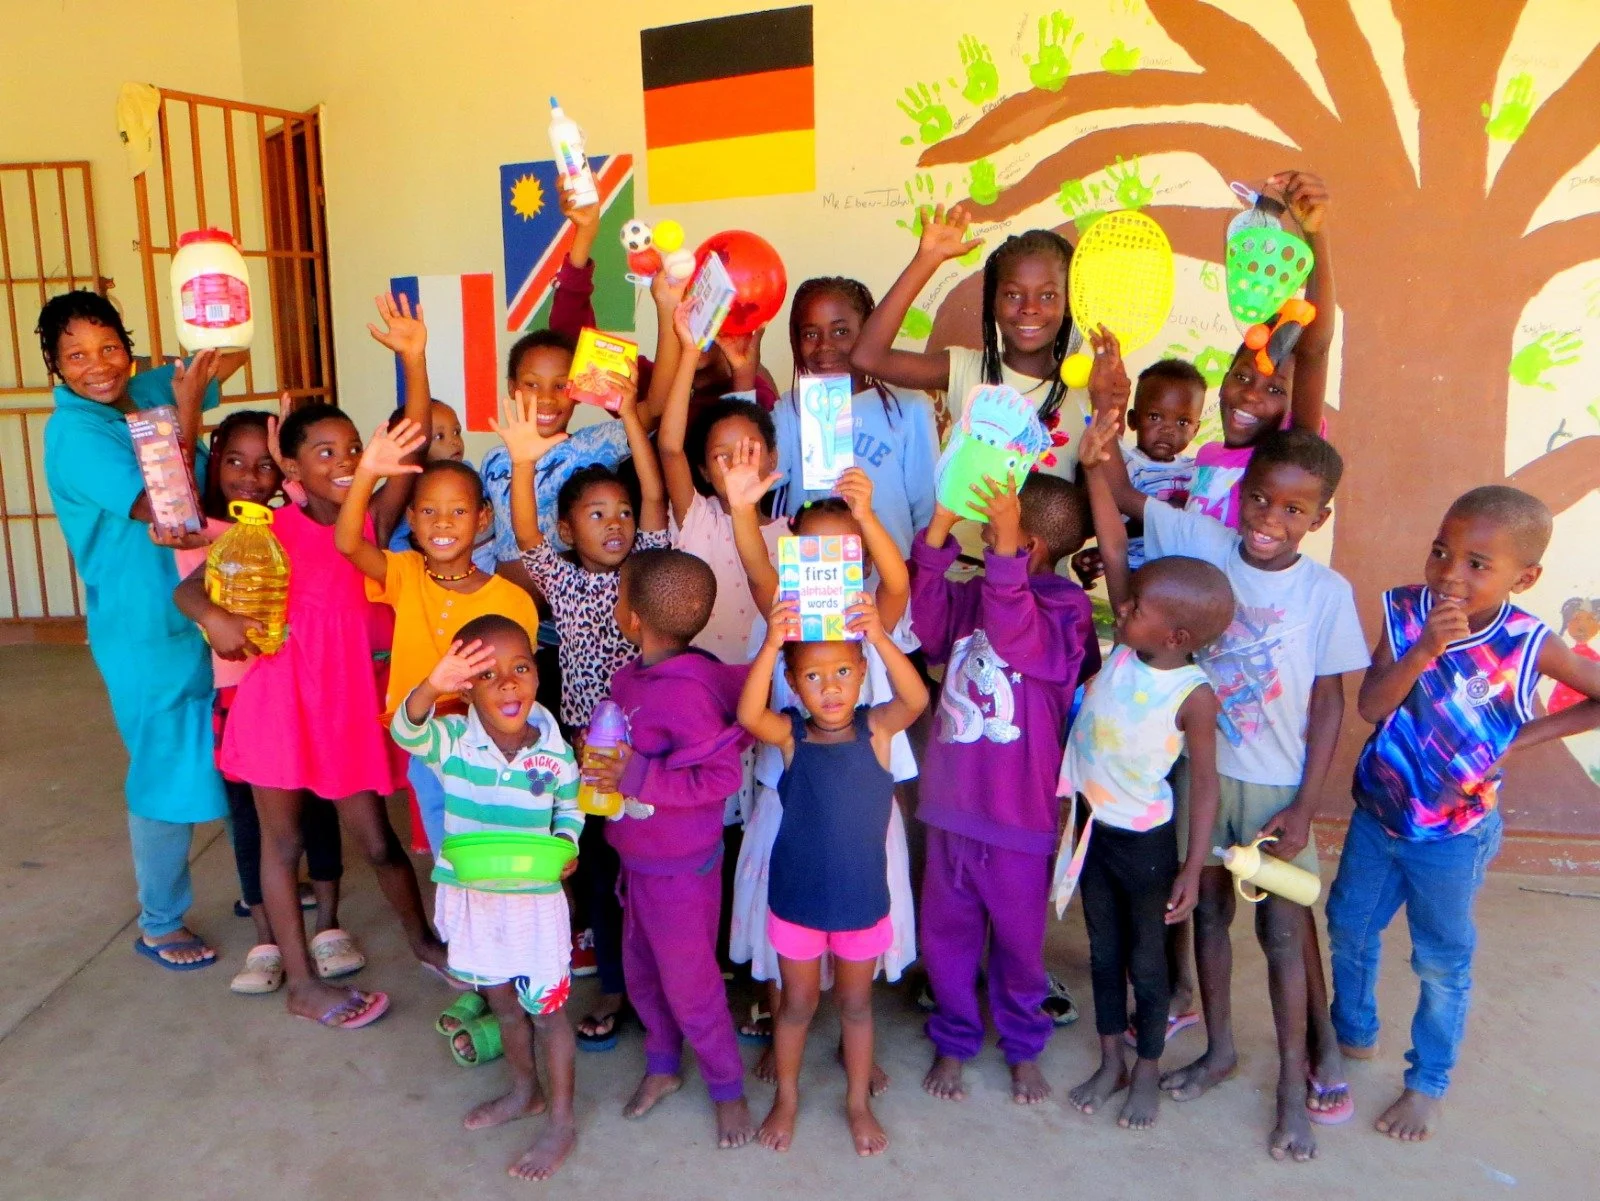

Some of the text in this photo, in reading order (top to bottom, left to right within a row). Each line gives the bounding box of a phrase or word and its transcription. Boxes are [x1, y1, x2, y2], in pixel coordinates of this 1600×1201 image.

[805, 566, 838, 581] first
[801, 584, 842, 597] alphabet
[807, 598, 839, 609] words
[523, 755, 561, 775] MICKEY
